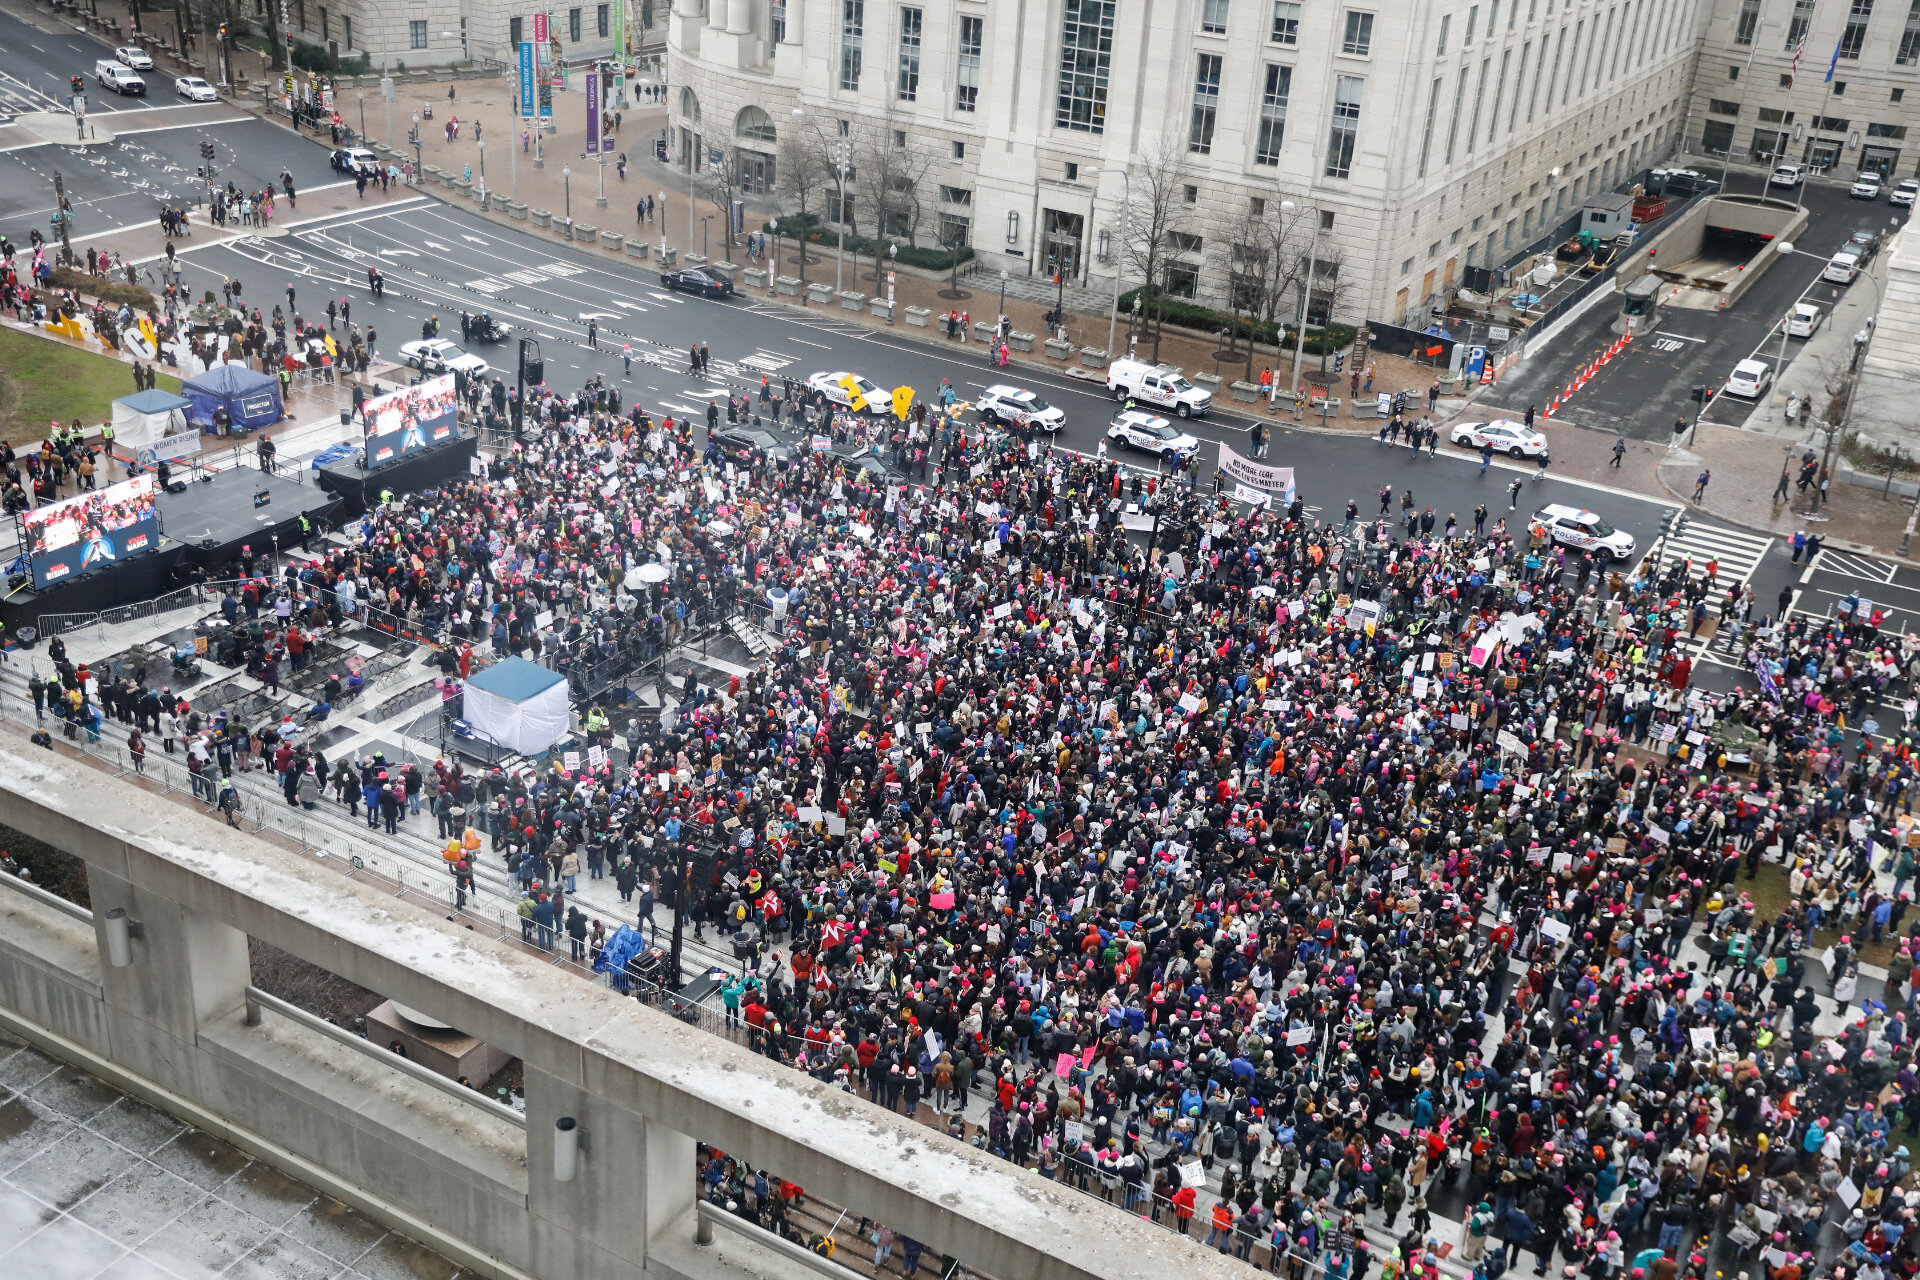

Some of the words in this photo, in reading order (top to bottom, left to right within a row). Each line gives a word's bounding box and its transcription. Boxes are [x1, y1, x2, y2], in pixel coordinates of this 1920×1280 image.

[1652, 338, 1684, 352] STOP
[1468, 347, 1484, 364] P
[825, 389, 847, 399] POLICE
[1141, 389, 1162, 398] POLICE
[247, 401, 270, 411] PRODUCTION
[996, 407, 1021, 417] POLICE
[153, 438, 178, 451] WOMEN
[179, 432, 199, 445] RISING
[1128, 434, 1152, 445] POLICE
[1486, 437, 1511, 446] POLICE
[1232, 459, 1241, 468] NO
[1240, 463, 1258, 476] MORE
[1225, 462, 1241, 477] TRANS
[1241, 472, 1258, 485] LIVES
[1258, 479, 1285, 489] MATTER
[1554, 530, 1582, 542] POLICE
[127, 538, 148, 552] MARCH
[46, 566, 70, 581] RISING
